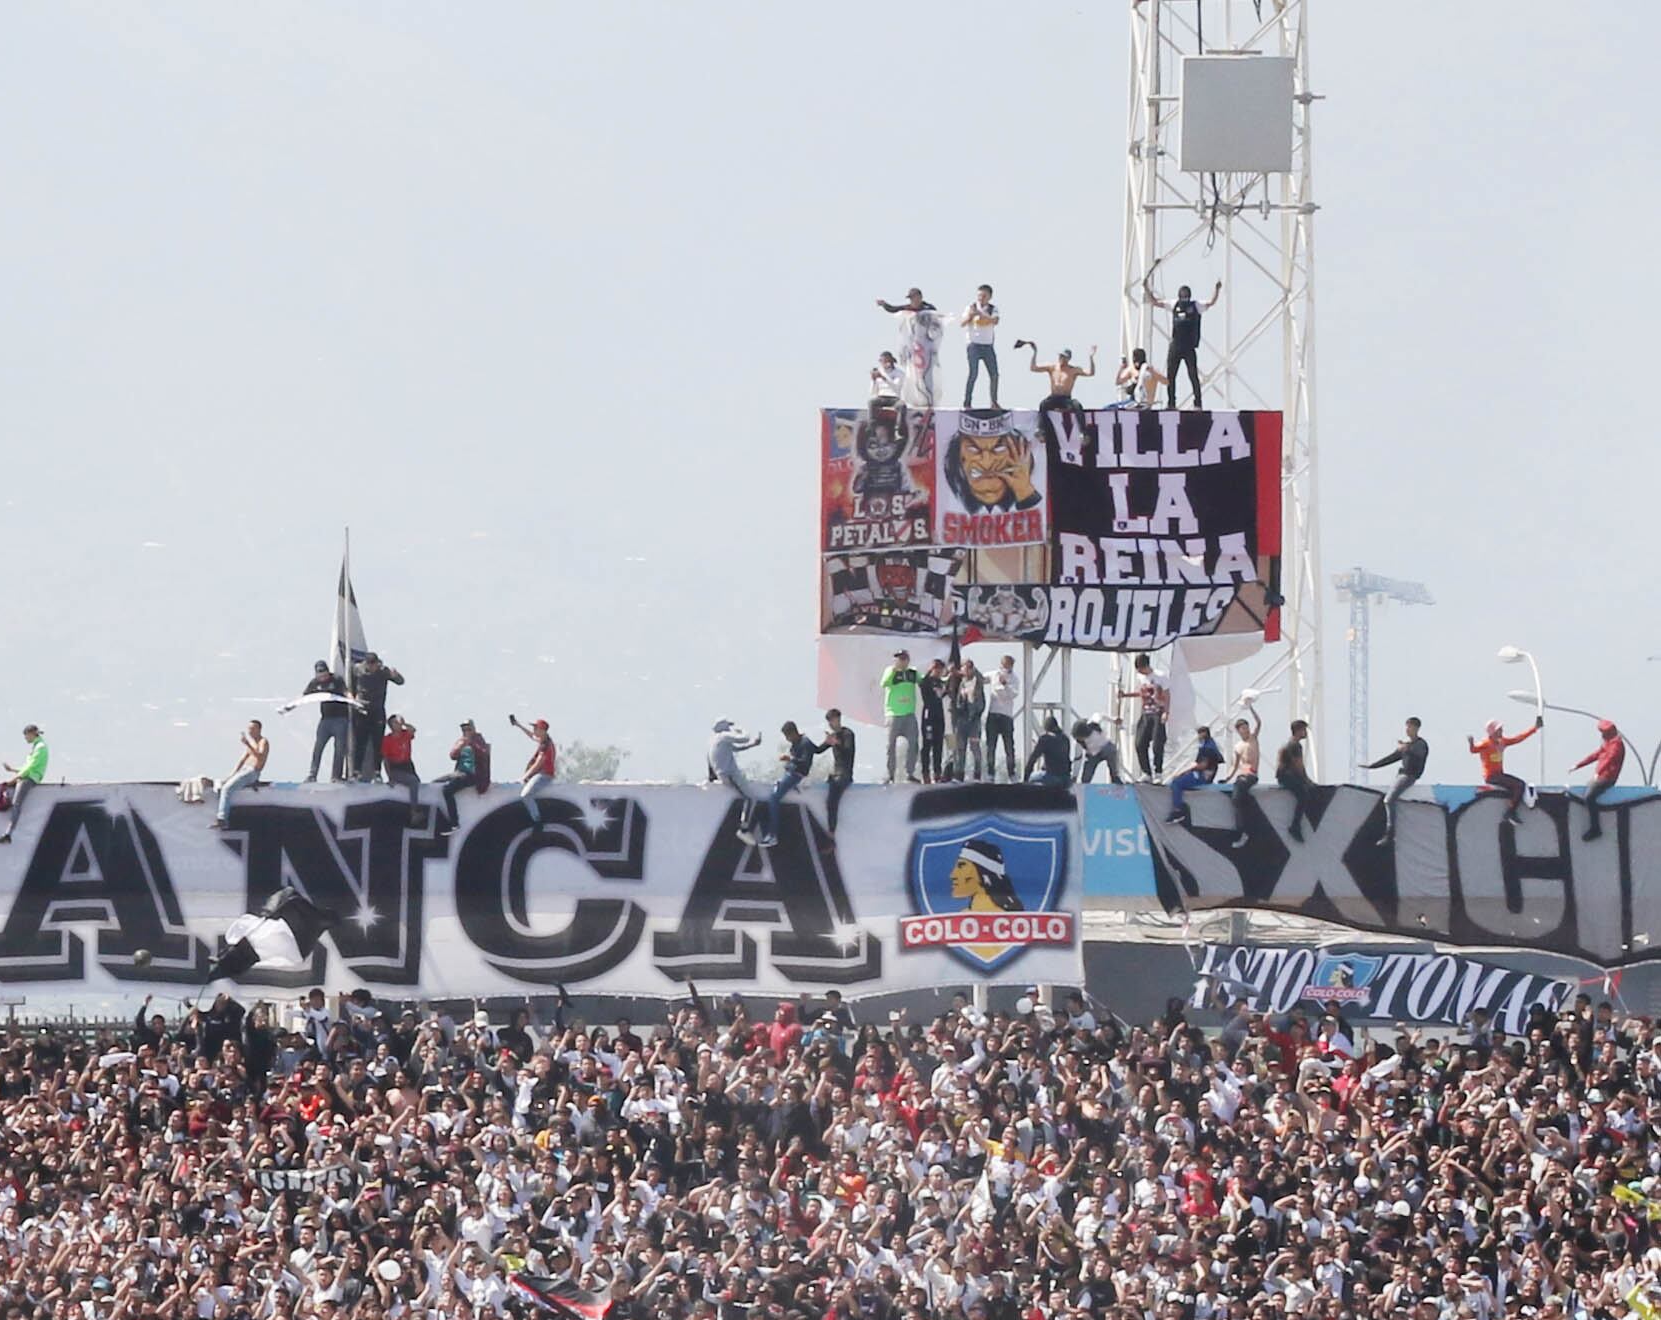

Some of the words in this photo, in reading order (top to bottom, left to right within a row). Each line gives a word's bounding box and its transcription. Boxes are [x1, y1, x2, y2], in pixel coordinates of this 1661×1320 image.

[1049, 410, 1251, 468] VILLA
[943, 509, 1044, 544] SMOKER
[1108, 472, 1199, 535] LA
[1059, 531, 1259, 585] REINA
